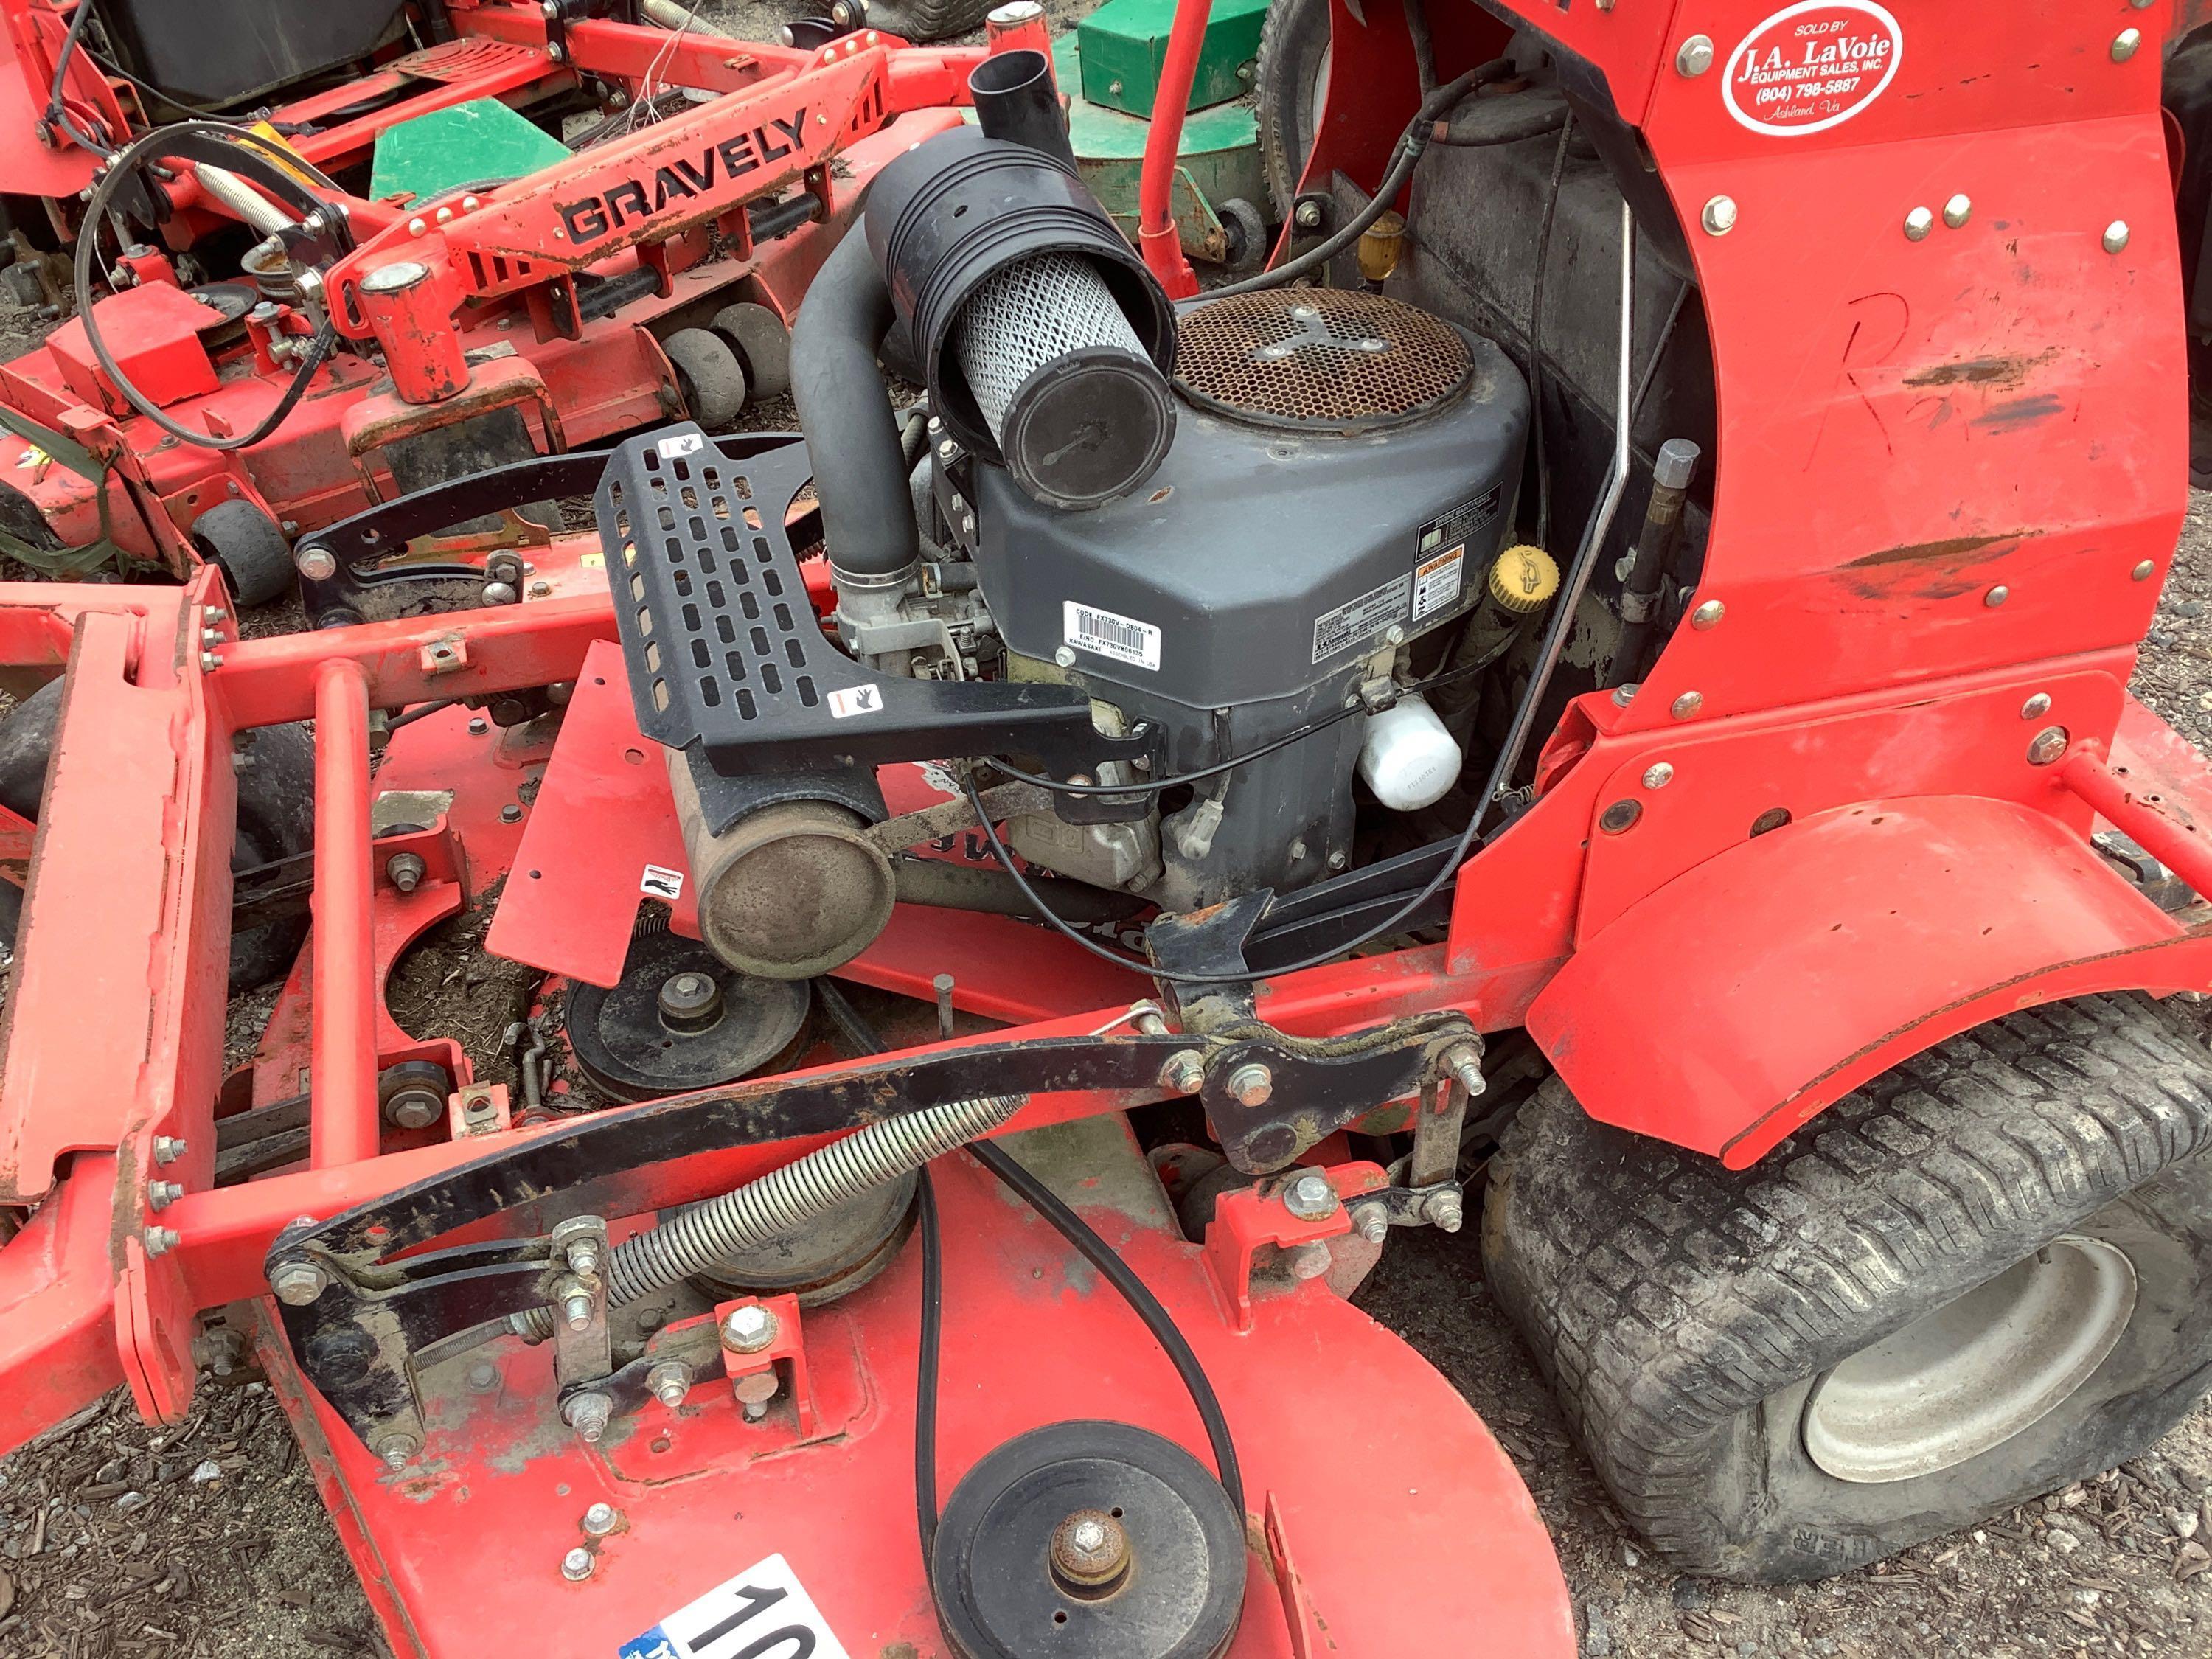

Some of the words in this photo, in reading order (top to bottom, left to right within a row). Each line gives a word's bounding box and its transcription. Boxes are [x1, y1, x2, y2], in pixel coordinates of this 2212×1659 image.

[1795, 22, 1829, 36] SOLD
[1830, 20, 1848, 32] BY
[1738, 46, 1790, 83] J.A.
[1802, 34, 1891, 64] LaVoie
[1751, 66, 1817, 84] EQUIPMENT
[1820, 61, 1860, 76] SALES,
[1862, 58, 1883, 72] INC.
[1756, 86, 1792, 105] (804)
[1795, 77, 1860, 98] 798-5887
[1819, 100, 1840, 113] Va
[560, 107, 807, 245] GRAVELY
[1427, 552, 1457, 571] WARNING
[1076, 608, 1092, 618] CODE
[1069, 638, 1102, 652] KAWASAKI
[1079, 633, 1094, 643] E/NO
